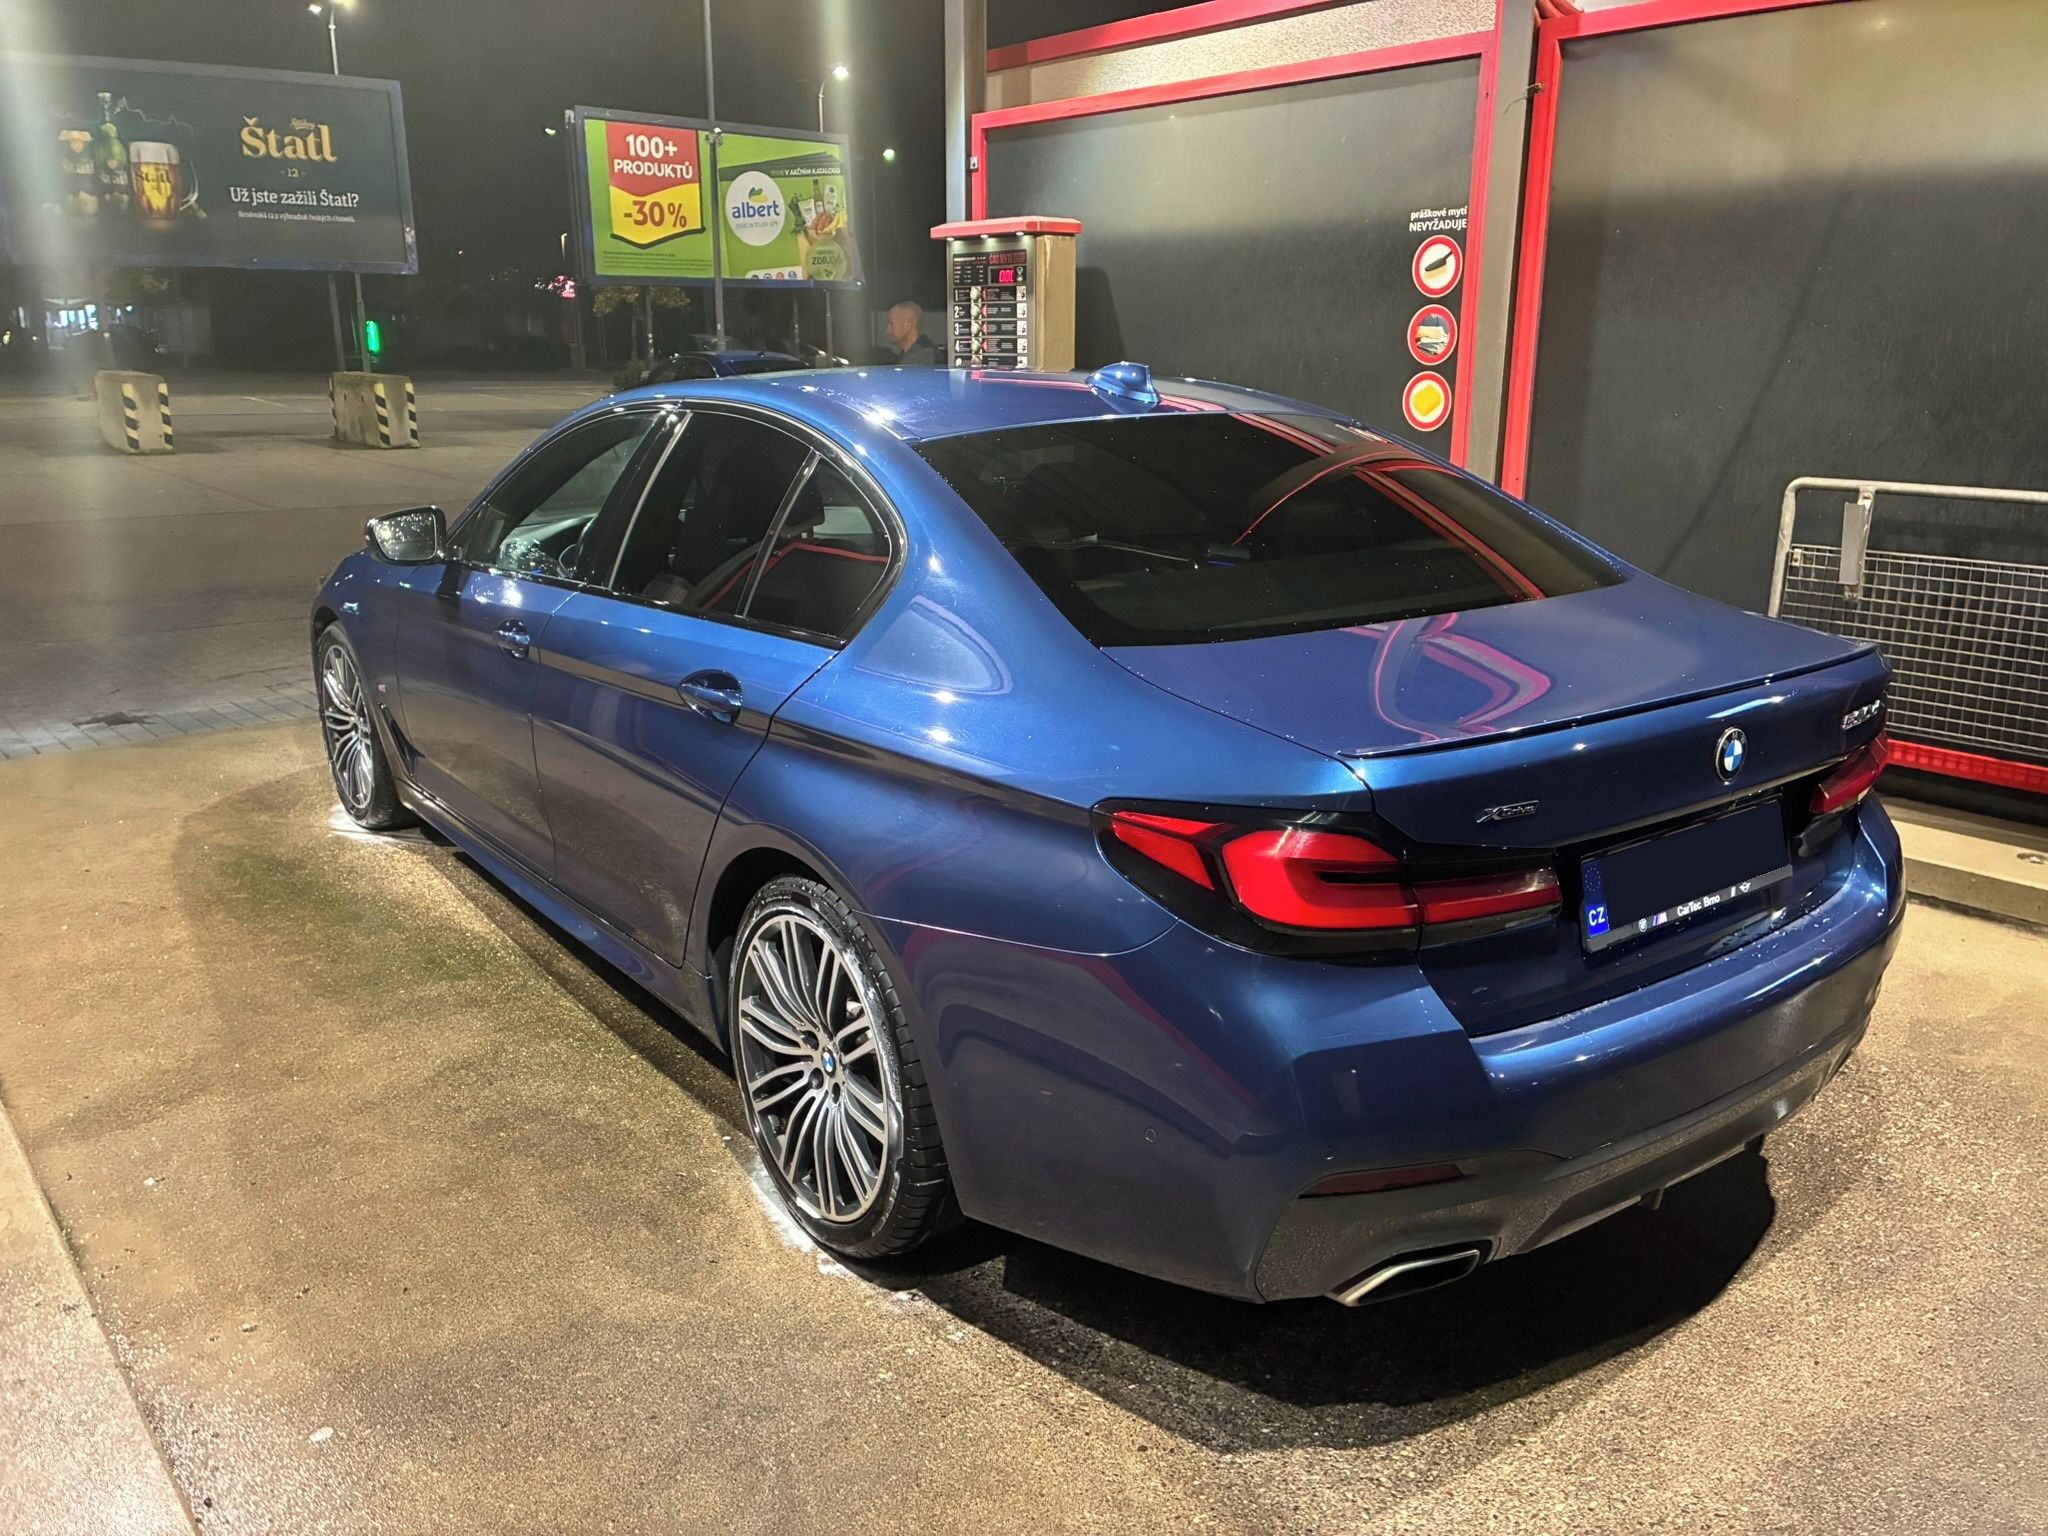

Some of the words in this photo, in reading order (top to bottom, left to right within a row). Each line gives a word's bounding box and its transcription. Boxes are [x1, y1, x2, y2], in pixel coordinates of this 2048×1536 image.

[241, 116, 337, 162] Štatl
[625, 134, 678, 158] 100+
[613, 158, 693, 180] PRODUKTŮ
[229, 186, 250, 203] Už
[251, 188, 278, 206] jste
[280, 190, 318, 206] zažili
[320, 189, 360, 208] Štatl?
[731, 200, 780, 219] albert
[1410, 207, 1447, 221] práškové
[1448, 205, 1468, 218] mytí
[1408, 218, 1468, 232] NEVYŽADUJE
[954, 306, 960, 319] 2
[954, 322, 960, 335] 3
[954, 340, 960, 352] 4
[1676, 900, 1702, 917] CarTec
[1703, 894, 1721, 908] Brno
[1588, 906, 1606, 927] CZ
